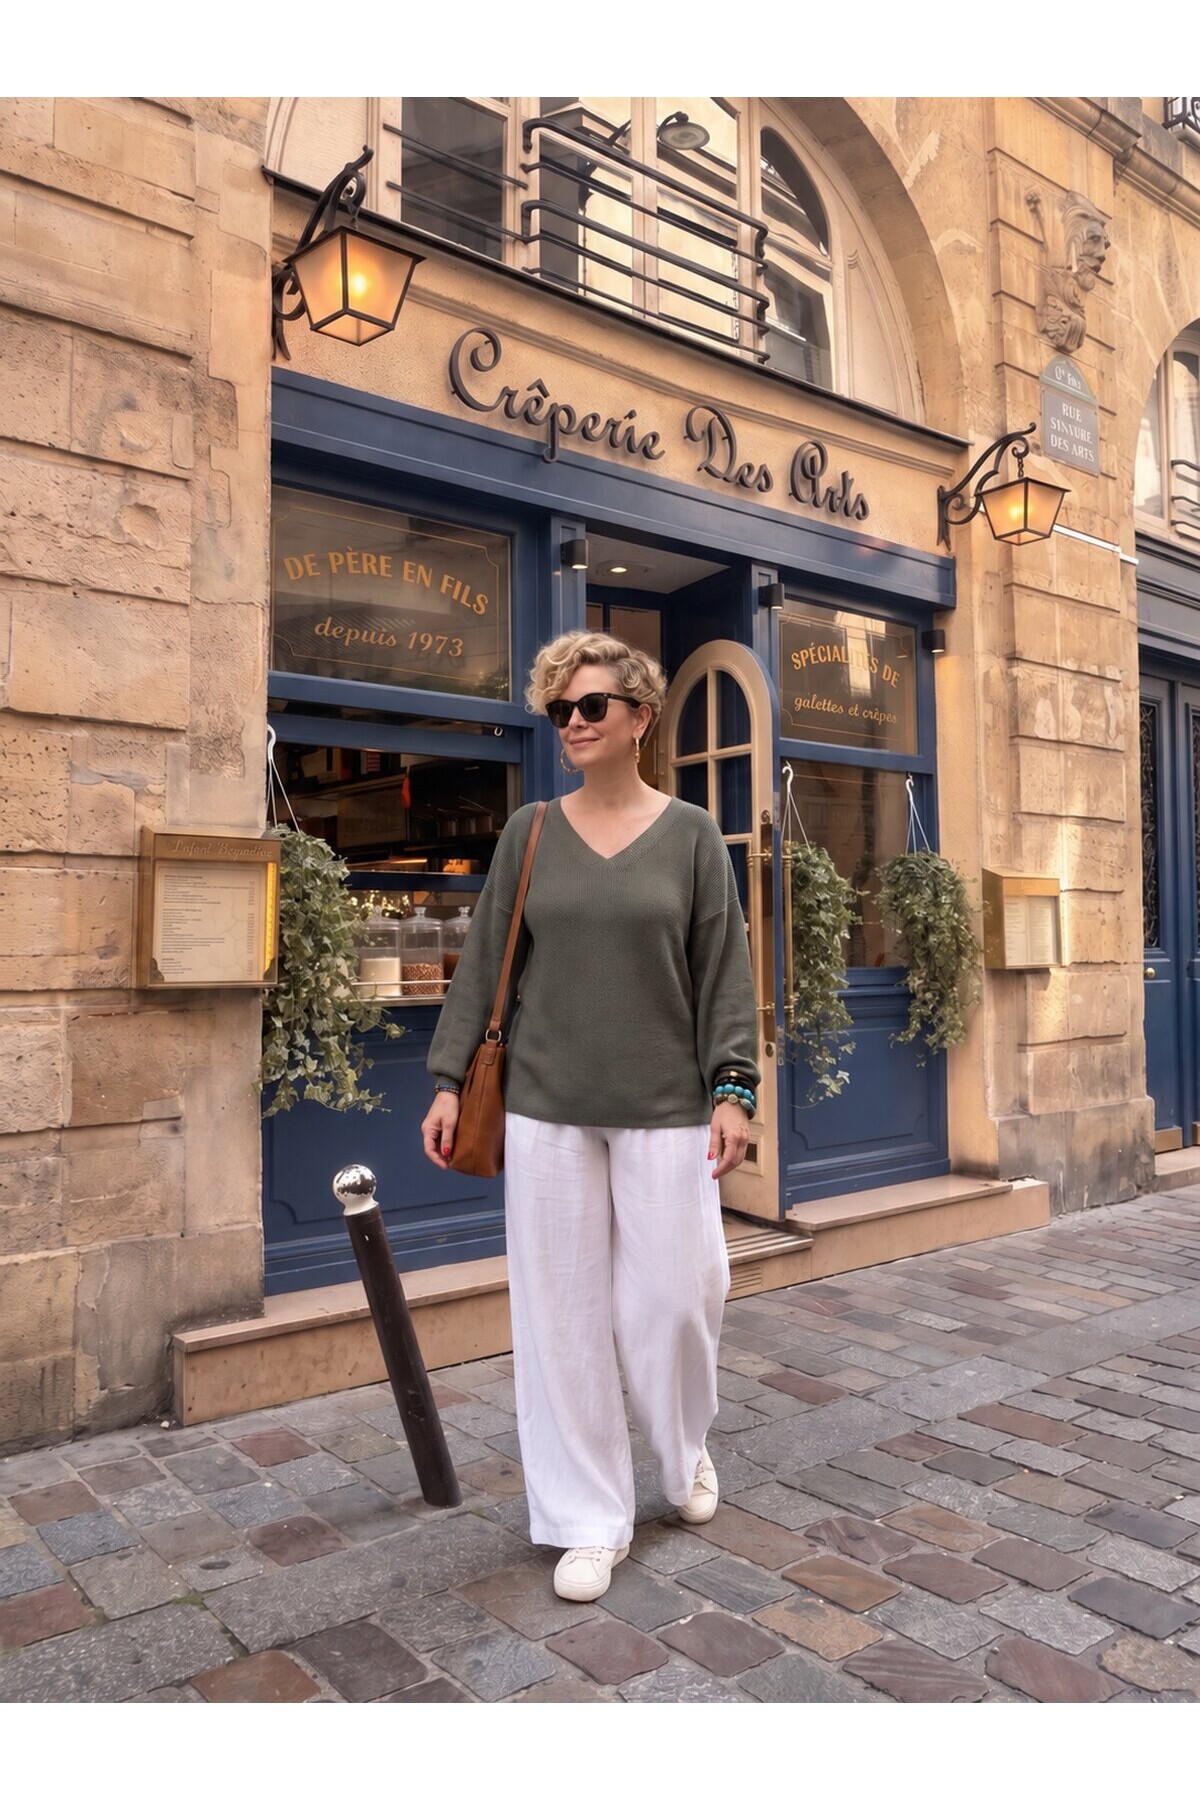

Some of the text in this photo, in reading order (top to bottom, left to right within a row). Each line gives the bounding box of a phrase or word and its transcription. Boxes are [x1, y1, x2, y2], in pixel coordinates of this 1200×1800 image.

[448, 327, 870, 521] Crêperie Des Arts
[1062, 402, 1082, 422] RUE
[1050, 434, 1095, 462] DES ARTS
[283, 546, 489, 615] DE PÈRE EN FILS
[313, 616, 464, 657] depuis 1973
[882, 664, 900, 688] DE
[794, 693, 898, 726] galettes et crêpes
